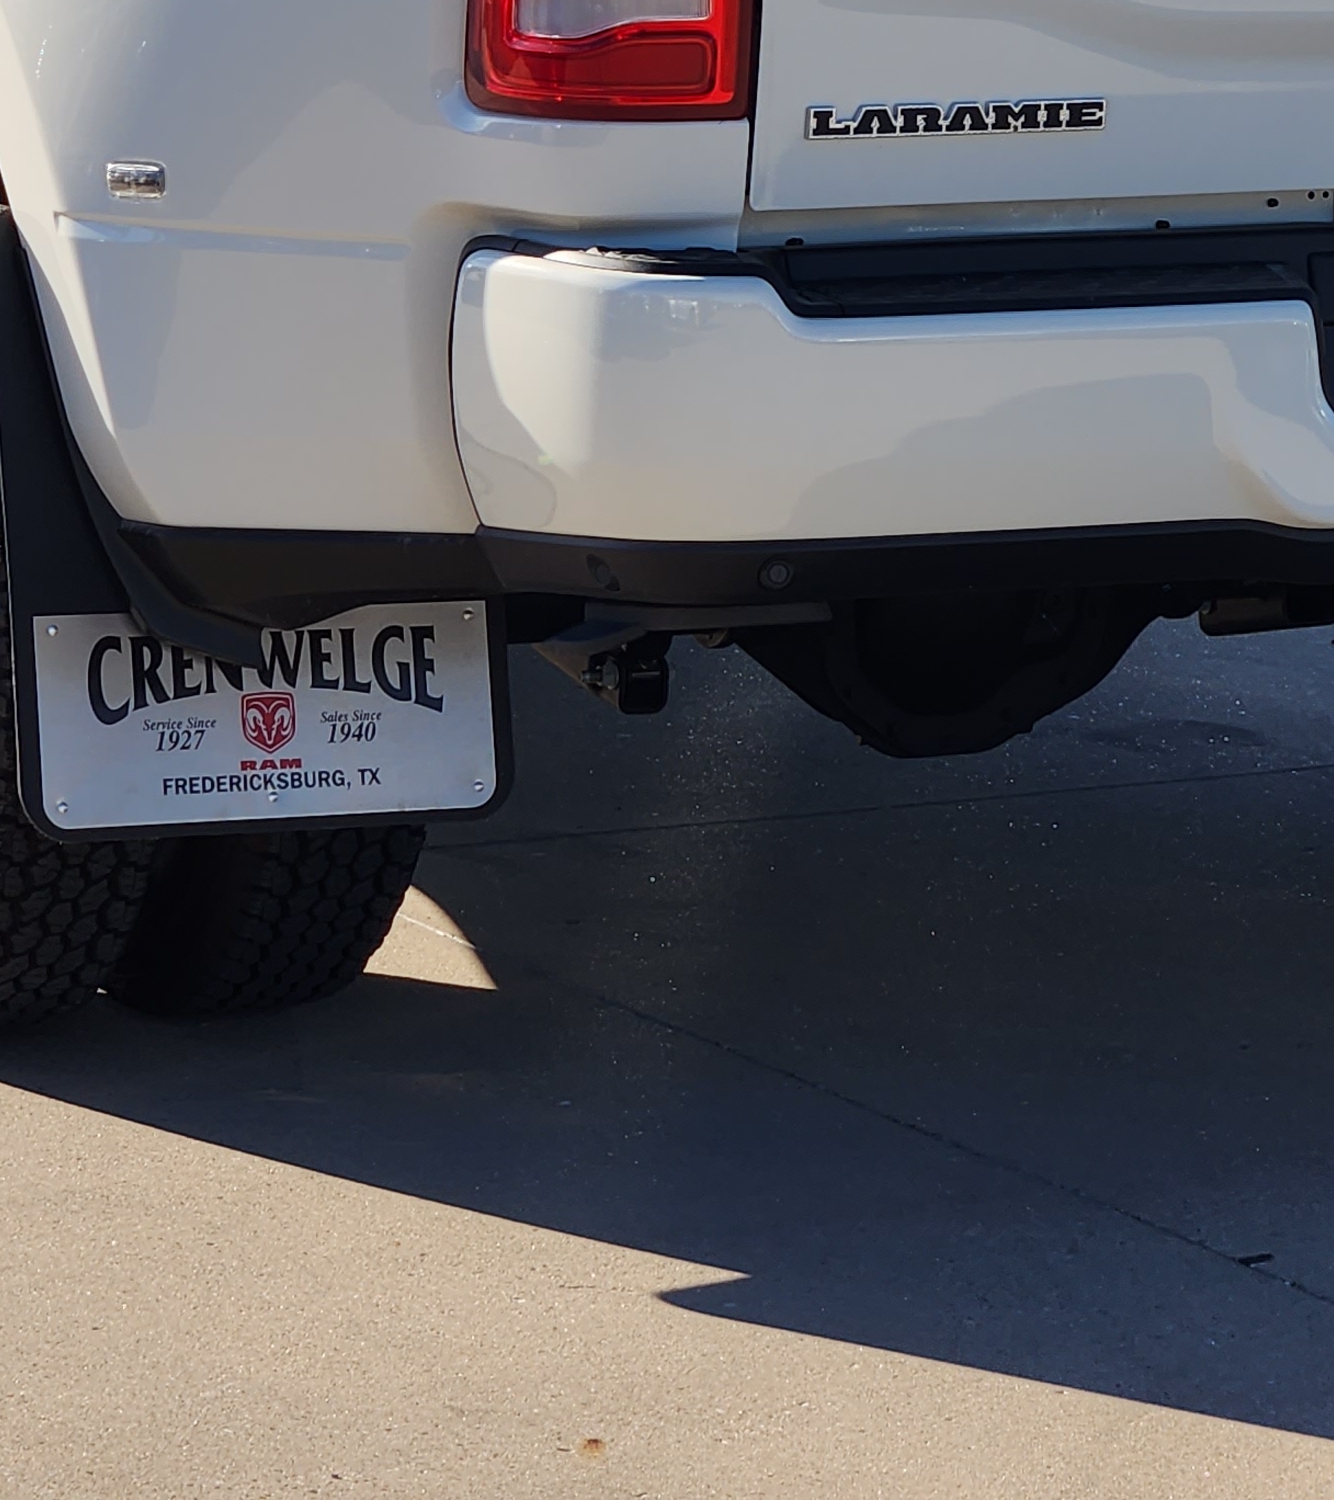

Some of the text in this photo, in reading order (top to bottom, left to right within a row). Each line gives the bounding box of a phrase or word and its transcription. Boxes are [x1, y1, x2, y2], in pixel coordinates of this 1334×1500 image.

[805, 98, 1106, 139] LARAMIE
[142, 717, 217, 732] Service Since
[320, 709, 382, 724] Sales Since
[155, 730, 206, 752] 1927
[327, 722, 376, 744] 1940
[240, 758, 302, 772] RAM
[162, 768, 382, 796] FREDERICKSBURG, TX
